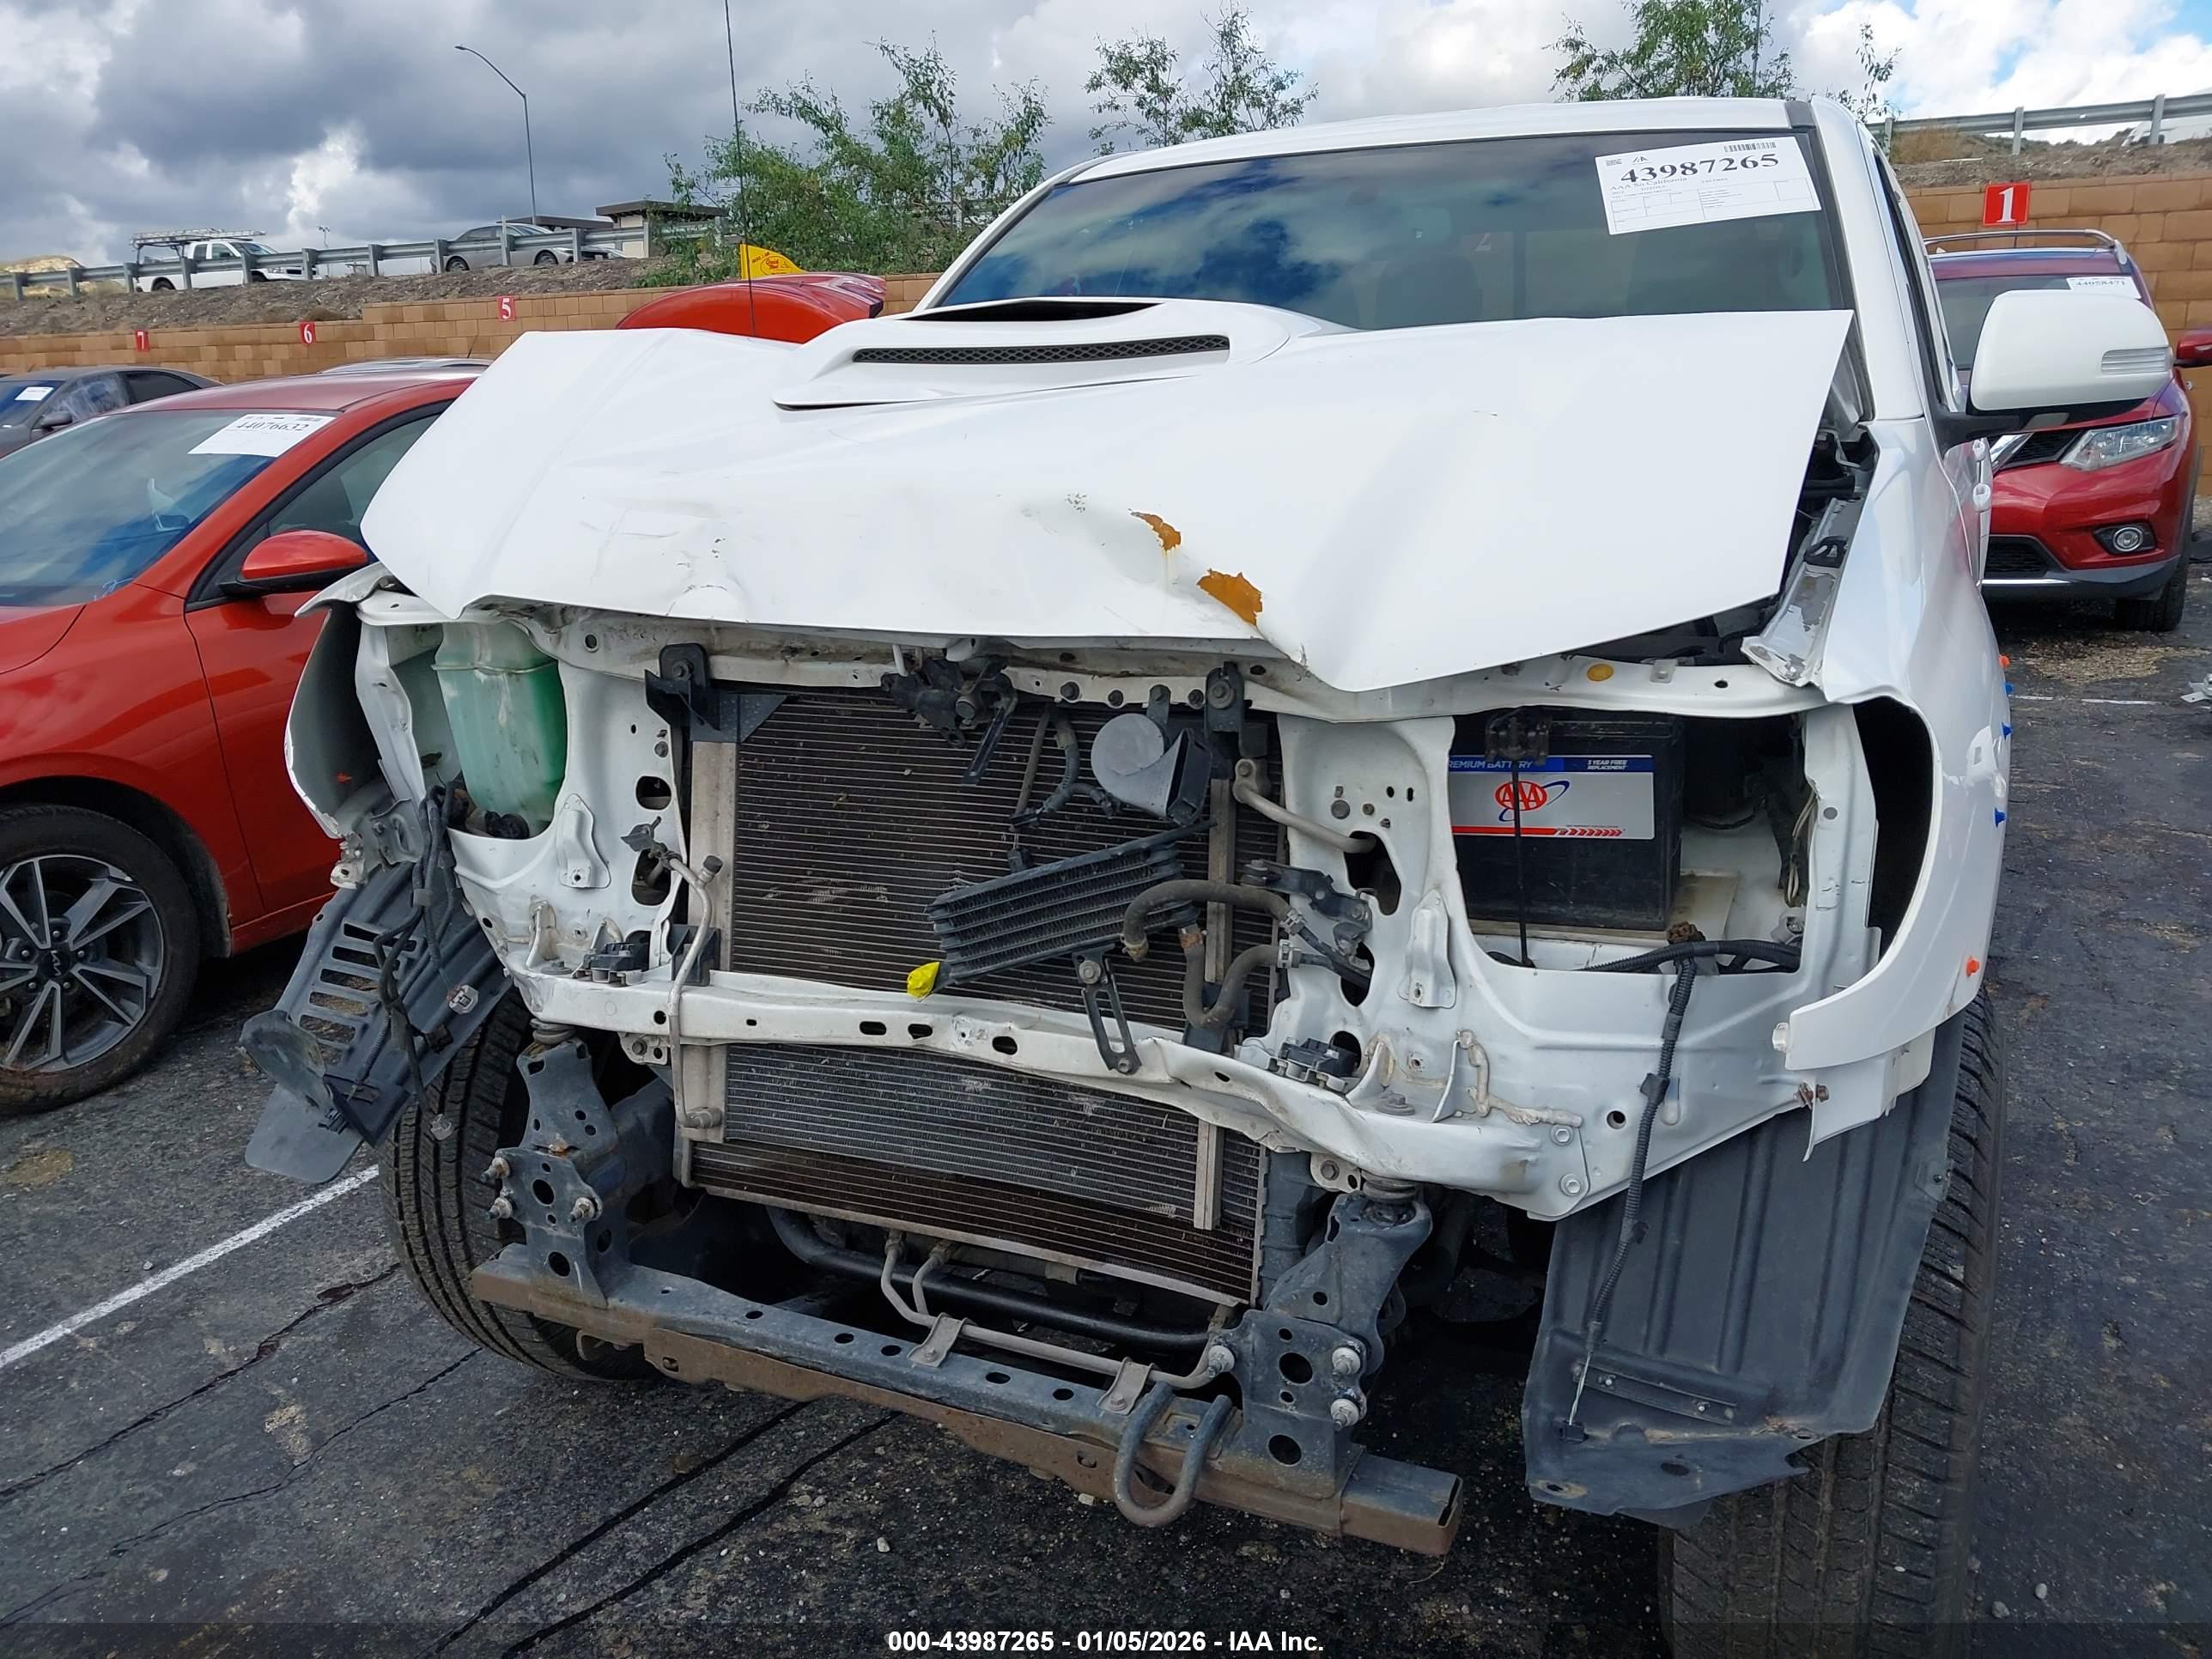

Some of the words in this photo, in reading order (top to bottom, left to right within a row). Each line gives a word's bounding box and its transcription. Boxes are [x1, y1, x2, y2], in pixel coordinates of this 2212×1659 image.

[1620, 153, 1779, 183] 43987265
[1996, 187, 2016, 222] 1
[501, 297, 512, 319] 5
[137, 331, 147, 350] 7
[303, 324, 313, 343] 6
[236, 422, 309, 431] 44076632
